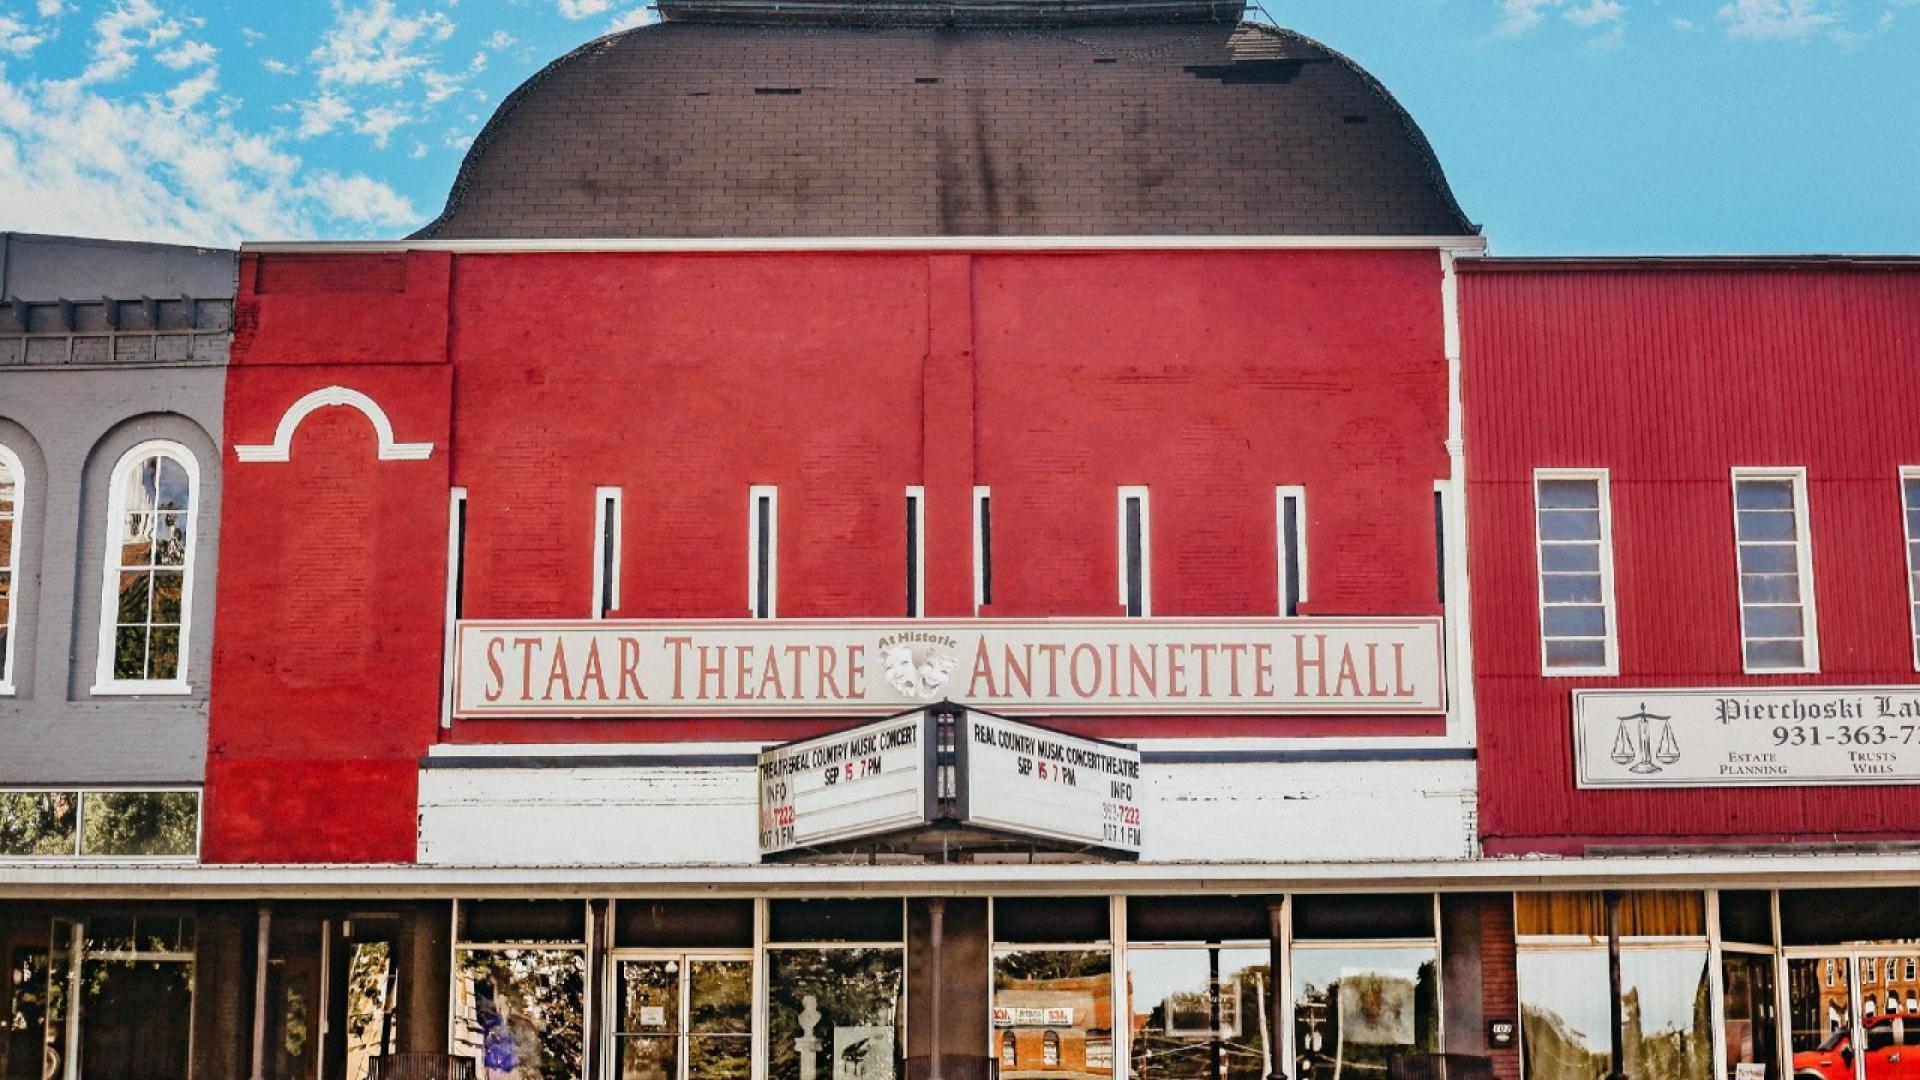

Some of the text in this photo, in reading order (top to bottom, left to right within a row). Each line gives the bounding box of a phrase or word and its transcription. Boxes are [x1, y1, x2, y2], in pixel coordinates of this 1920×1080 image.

[878, 631, 957, 649] At Historic
[485, 636, 867, 702] STAAR THEATRE
[966, 634, 1416, 699] ANTOINETTE HALL
[1715, 697, 1863, 725] Pierchoski
[1773, 725, 1920, 747] 931-363-7
[791, 725, 917, 774] REAL COUNTRY MUSIC CONCERT
[974, 723, 1100, 772] REAL COUNTRY MUSIC CONCERT
[1728, 752, 1777, 763] ESTATE
[1847, 751, 1897, 762] TRUSTS
[760, 758, 793, 780] THEATRE
[824, 756, 882, 786] SEP 15 7 PM
[1017, 757, 1076, 786] SEP 15 7 PM
[1101, 755, 1140, 780] THEATRE
[1719, 765, 1788, 776] PLANNING
[1853, 763, 1894, 774] WILLS
[767, 784, 787, 803] INFO
[1110, 781, 1132, 801] INFO
[1128, 827, 1141, 847] FM
